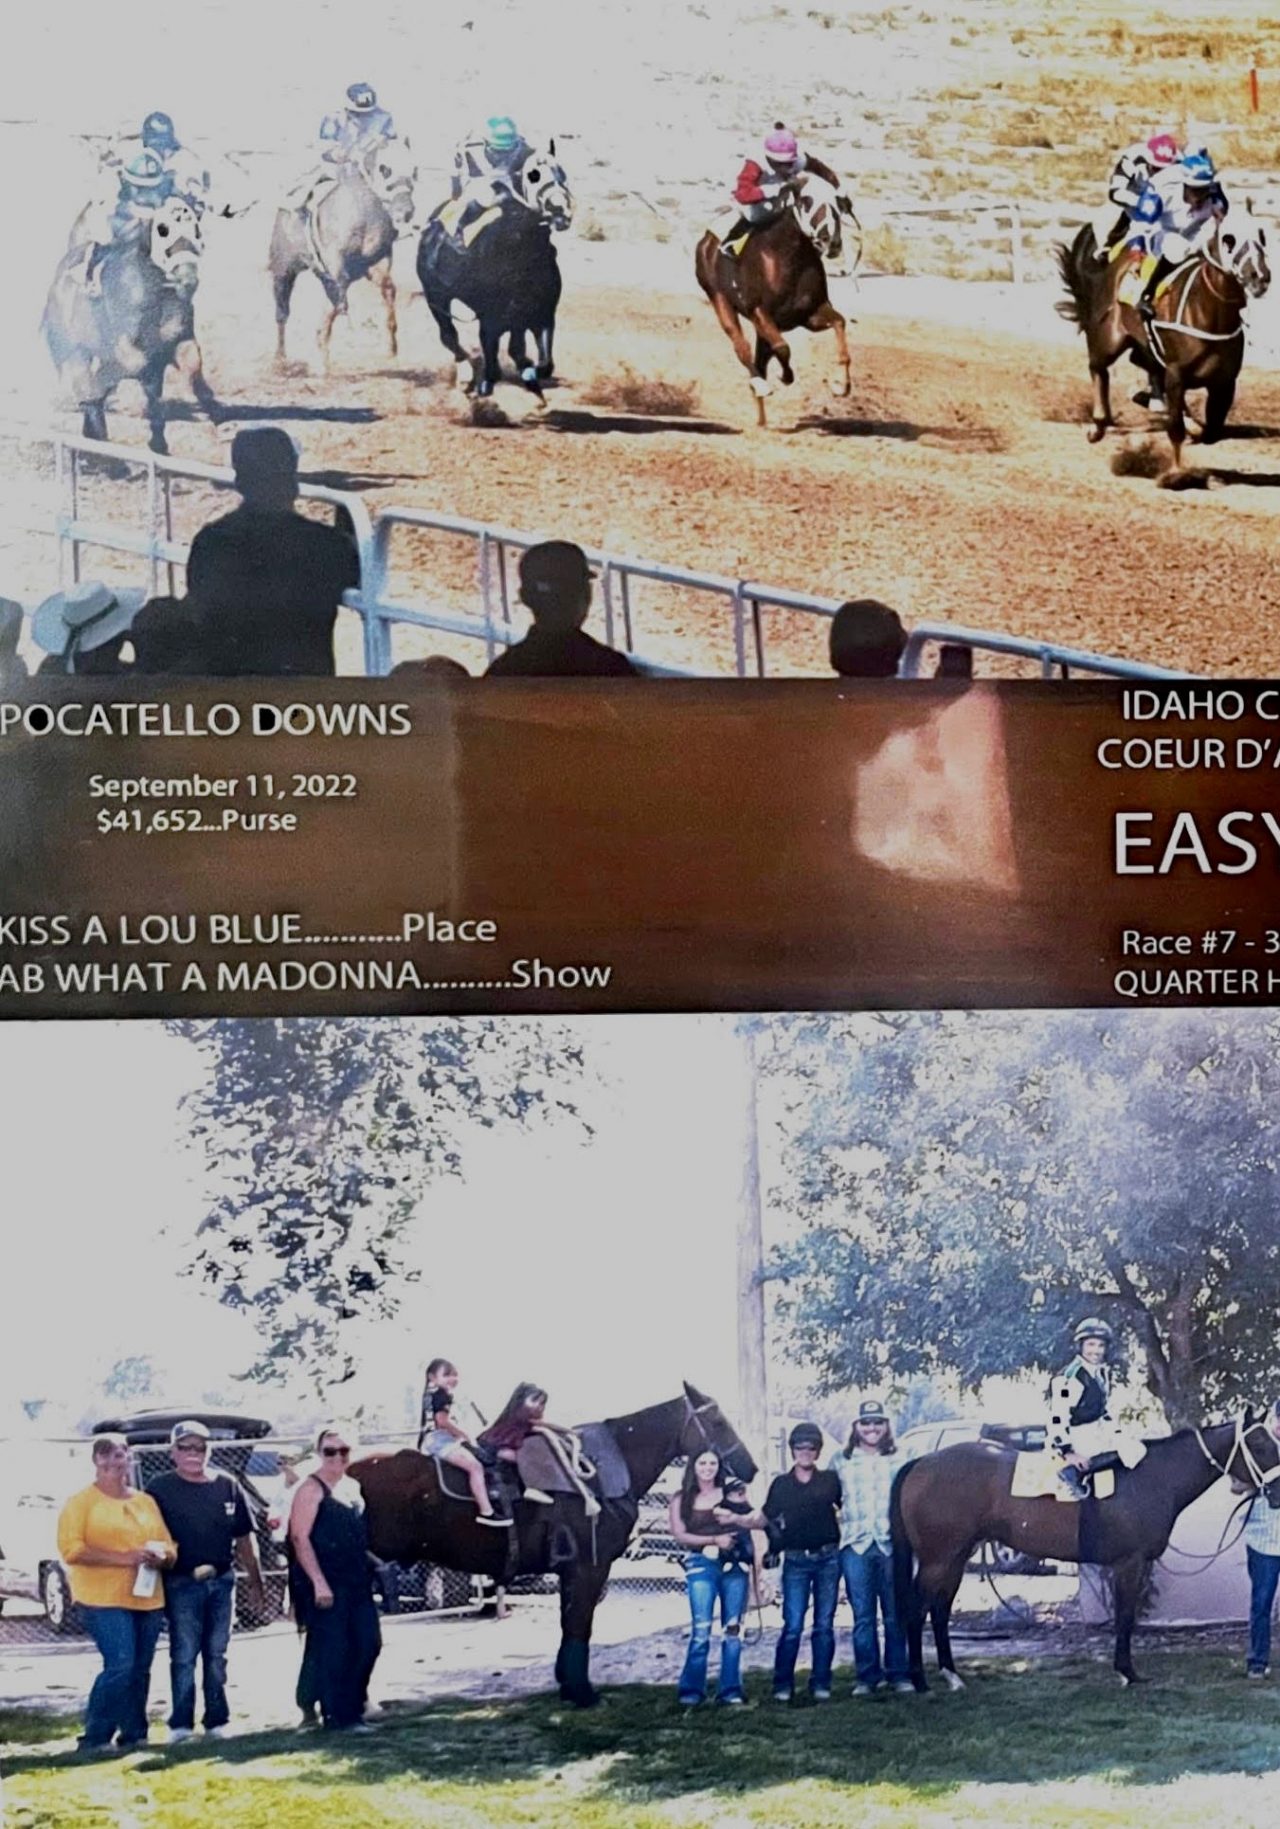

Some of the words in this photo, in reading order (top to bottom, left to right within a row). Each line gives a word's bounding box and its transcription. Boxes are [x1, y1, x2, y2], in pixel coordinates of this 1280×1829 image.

[0, 702, 240, 736] POCATELLO
[252, 703, 412, 736] DOWNS
[1123, 690, 1245, 720] IDAHO
[1097, 738, 1226, 768] COEUR
[89, 774, 239, 803] September
[247, 774, 286, 800] 11,
[292, 774, 357, 797] 2022
[0, 915, 70, 945] KISS
[82, 915, 108, 945] A
[120, 915, 197, 945] LOU
[1122, 930, 1192, 955] Race
[1202, 930, 1237, 954] #7
[0, 962, 46, 994] AB
[54, 962, 172, 993] WHAT
[181, 962, 207, 992] A
[1113, 968, 1259, 998] QUARTER
